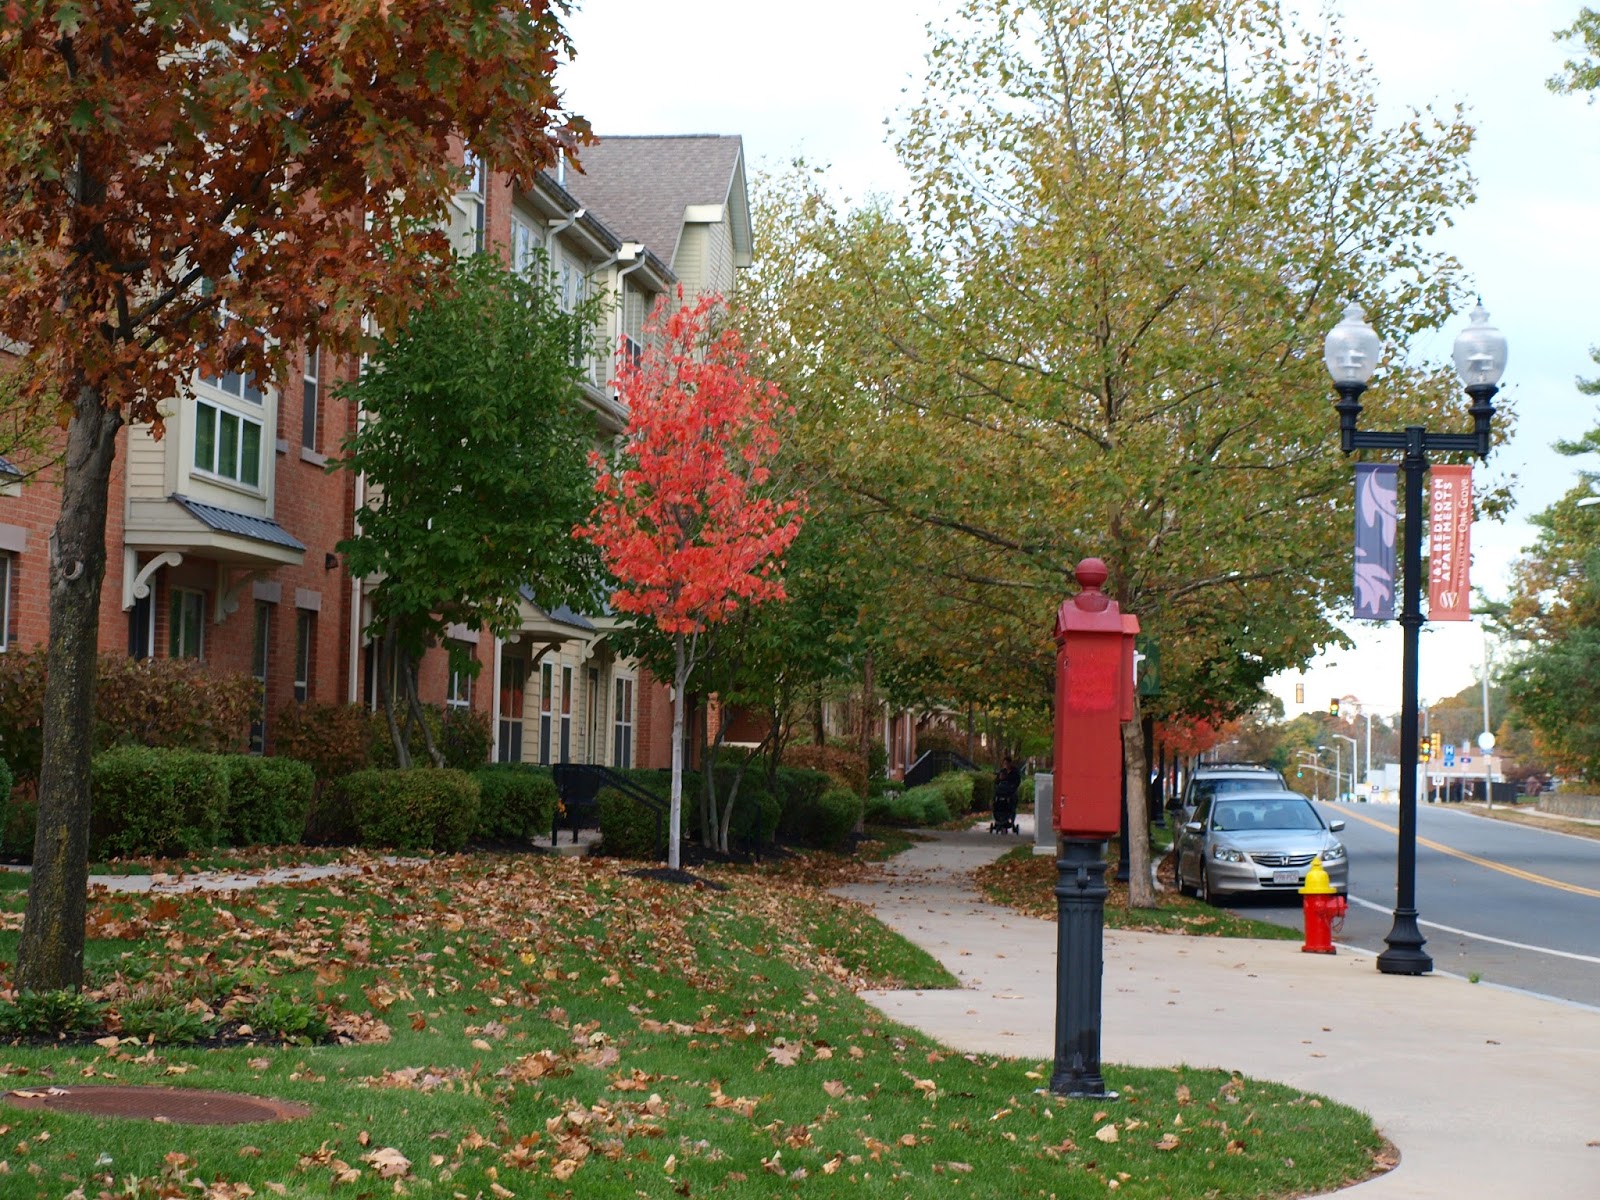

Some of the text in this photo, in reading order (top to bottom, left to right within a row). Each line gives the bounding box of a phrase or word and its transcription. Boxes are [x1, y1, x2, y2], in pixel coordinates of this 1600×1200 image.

[1434, 478, 1443, 551] BEDROOM
[1458, 479, 1469, 508] Grove
[1442, 482, 1452, 582] APARTMENTS
[1458, 511, 1468, 533] Oak
